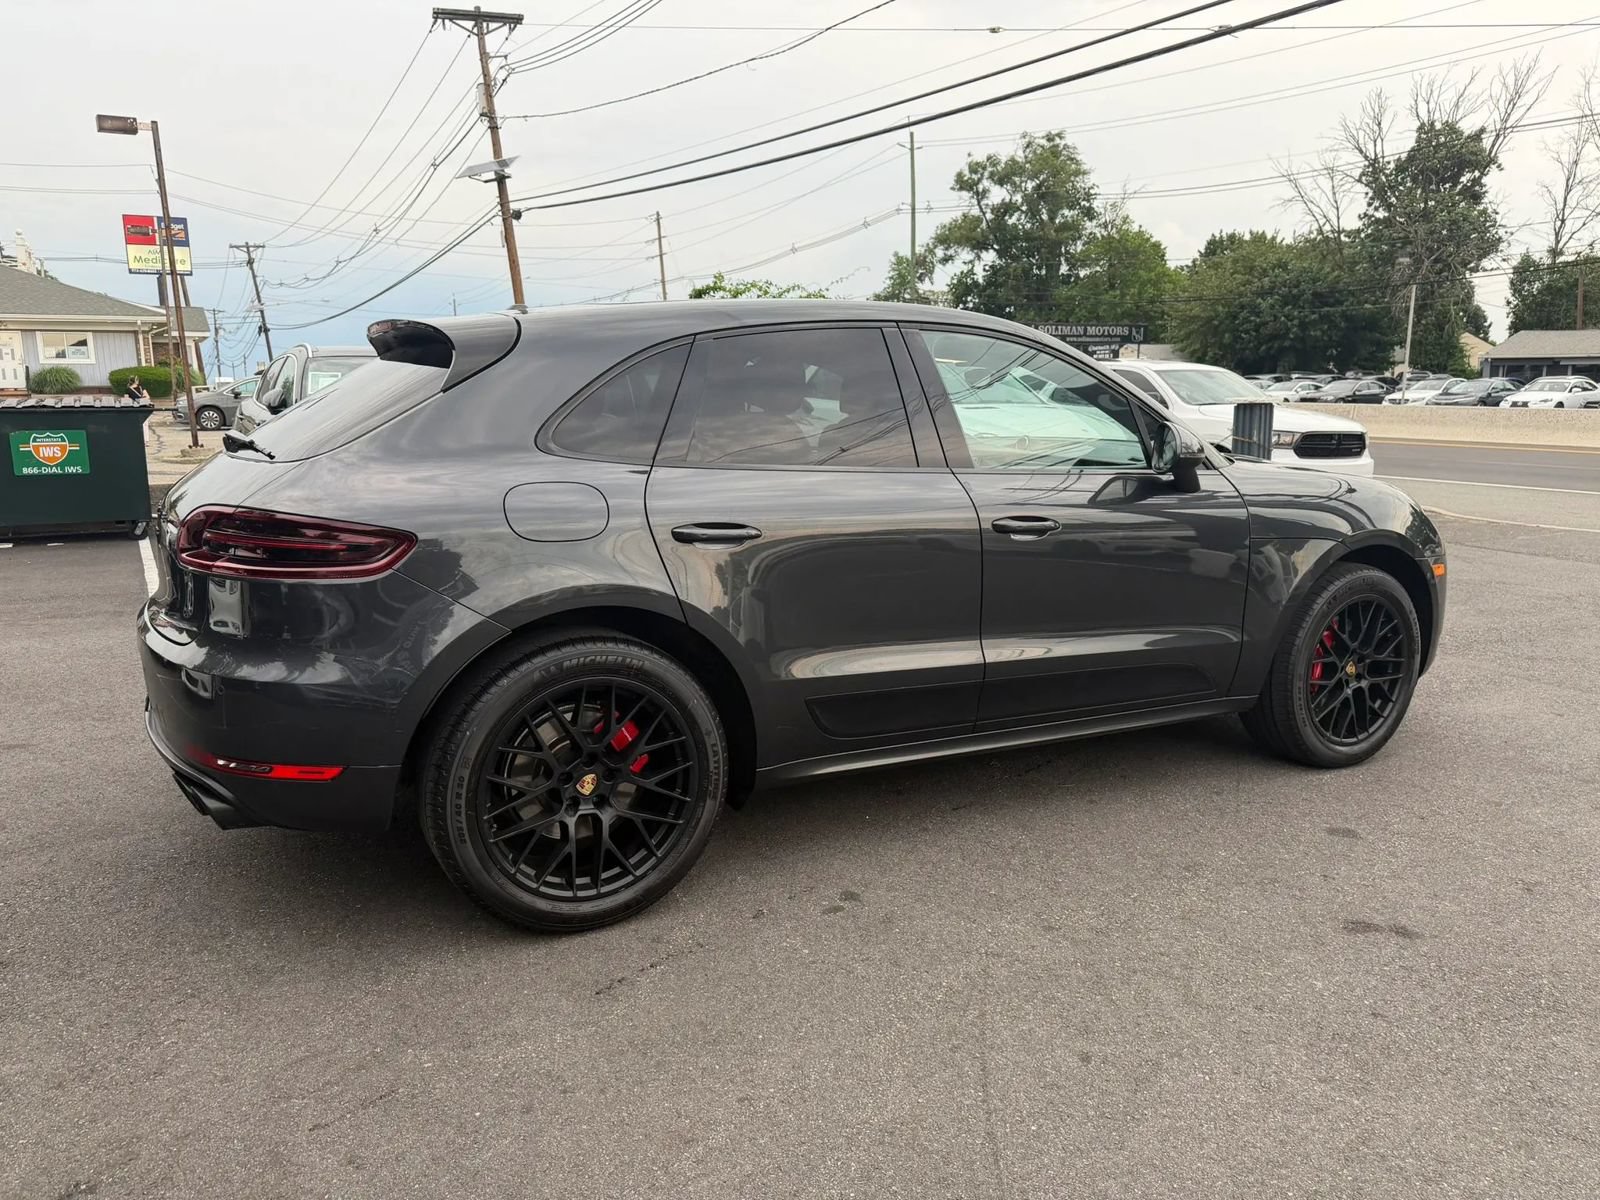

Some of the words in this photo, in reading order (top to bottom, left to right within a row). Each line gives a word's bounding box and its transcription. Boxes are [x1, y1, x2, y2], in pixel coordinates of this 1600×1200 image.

[161, 222, 184, 231] Bget
[133, 255, 186, 266] Medire
[1038, 324, 1085, 336] SOLIMAN
[1086, 326, 1129, 336] MOTORS
[39, 446, 62, 457] IWS
[22, 466, 62, 474] 866-DIAL
[64, 465, 82, 473] IWS
[562, 655, 644, 669] MICHELIN
